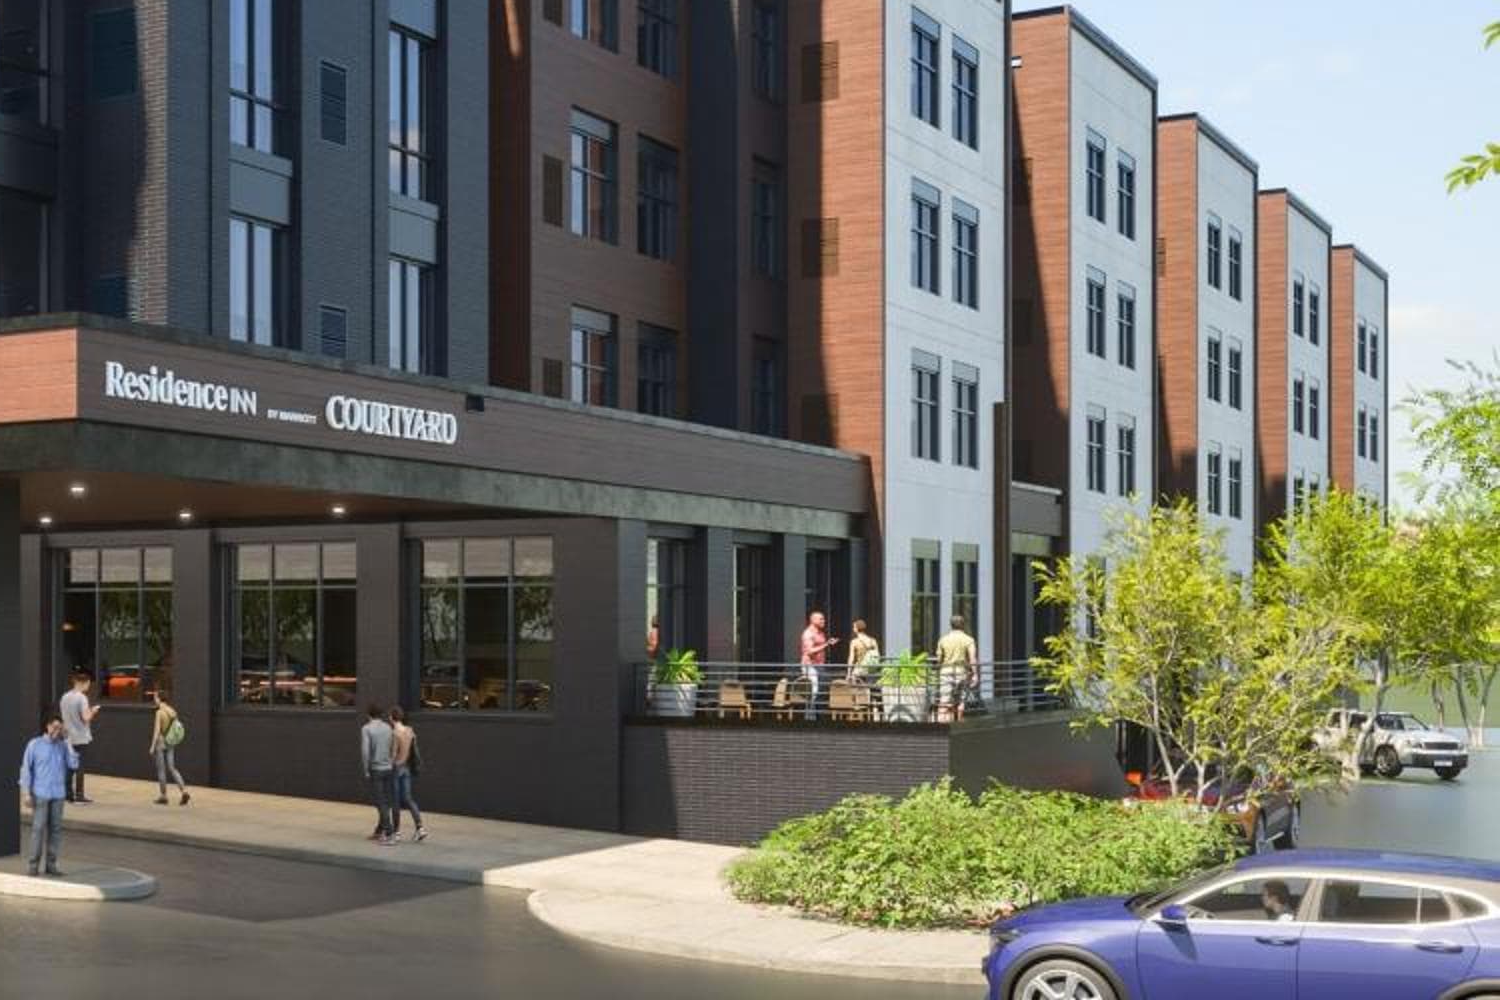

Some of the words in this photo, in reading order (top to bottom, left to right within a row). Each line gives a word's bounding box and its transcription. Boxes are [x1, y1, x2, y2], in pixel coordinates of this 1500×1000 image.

[105, 360, 229, 411] Residence
[230, 387, 257, 416] INN
[325, 395, 458, 445] COURTYARD
